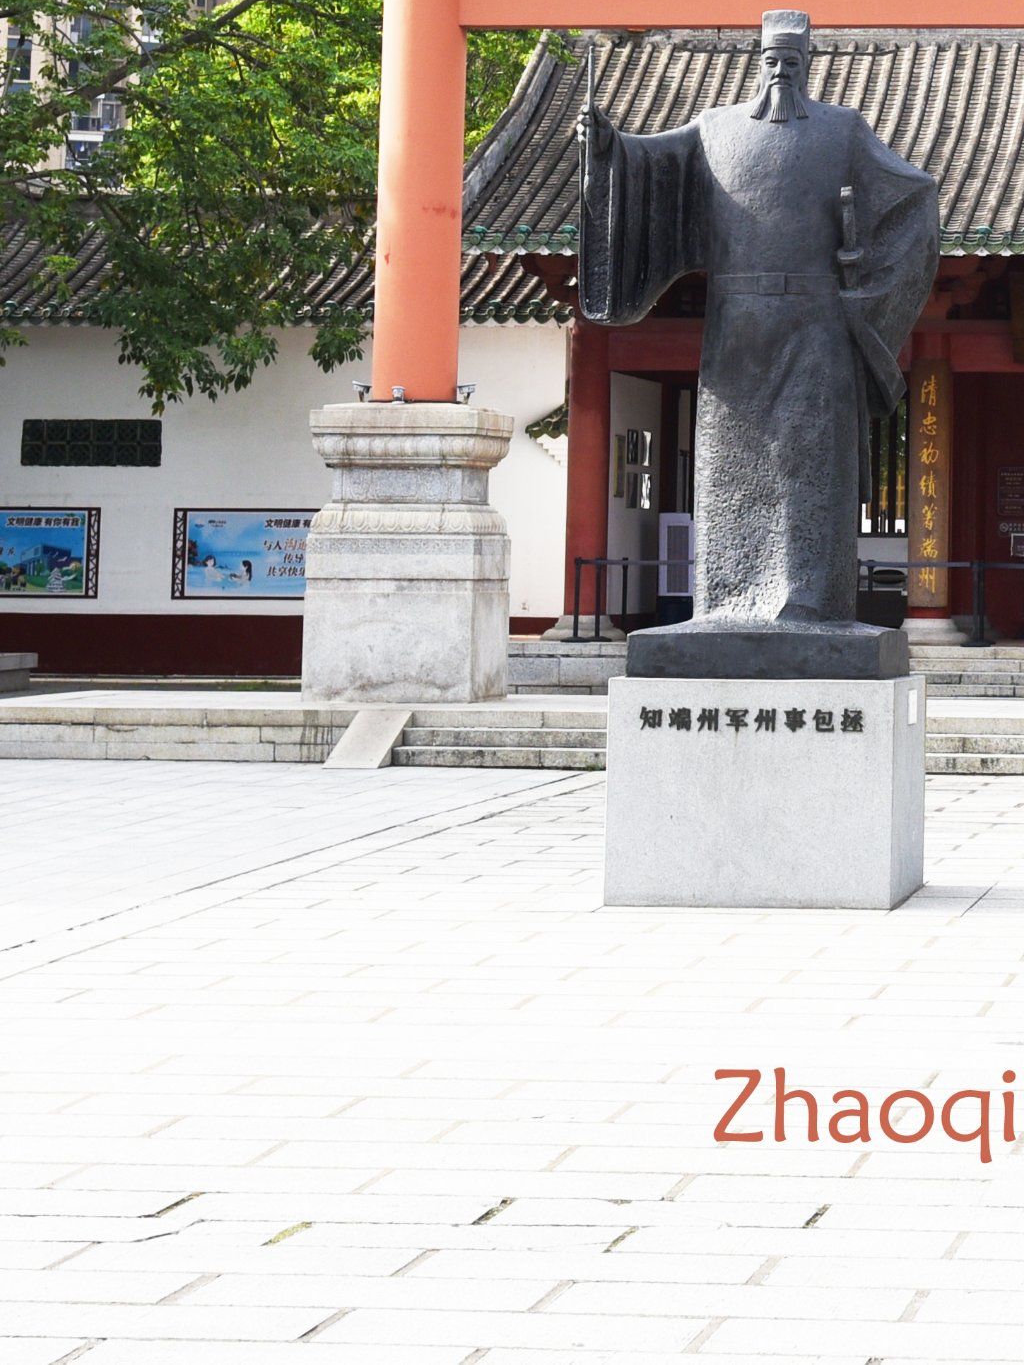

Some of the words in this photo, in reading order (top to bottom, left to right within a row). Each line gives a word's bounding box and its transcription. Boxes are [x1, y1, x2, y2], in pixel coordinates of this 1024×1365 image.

[265, 519, 300, 528] 文明健康
[639, 706, 864, 733] 知端州军州事包拯
